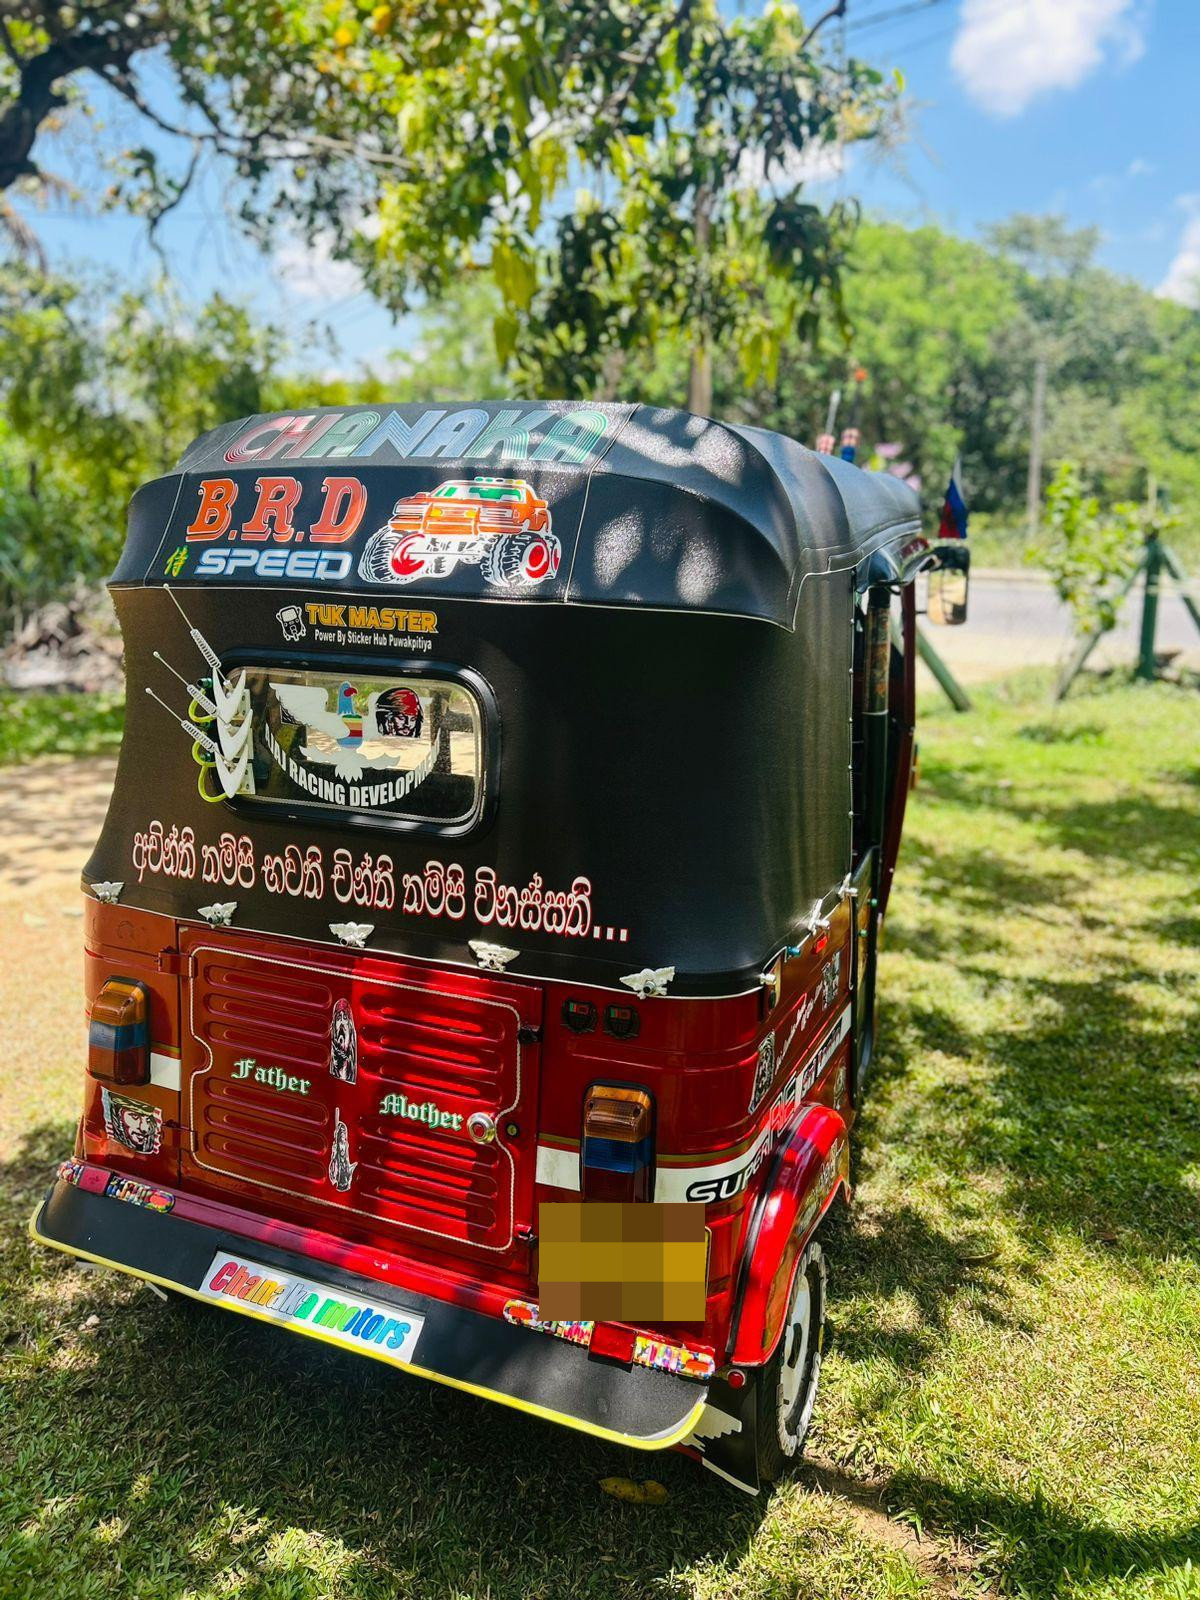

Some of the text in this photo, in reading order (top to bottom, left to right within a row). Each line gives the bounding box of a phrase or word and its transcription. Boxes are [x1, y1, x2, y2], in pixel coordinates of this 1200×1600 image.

[224, 408, 608, 464] CHANAKA
[186, 476, 368, 543] B.R.D
[194, 547, 354, 581] SPEED
[305, 602, 439, 634] TUK MASTER
[314, 629, 432, 652] Power By Sticker Hub Puwakpitiya
[289, 757, 346, 806] RACING
[230, 1057, 312, 1096] Father
[379, 1092, 463, 1132] Mother
[208, 1261, 412, 1350] Chanaka motors
